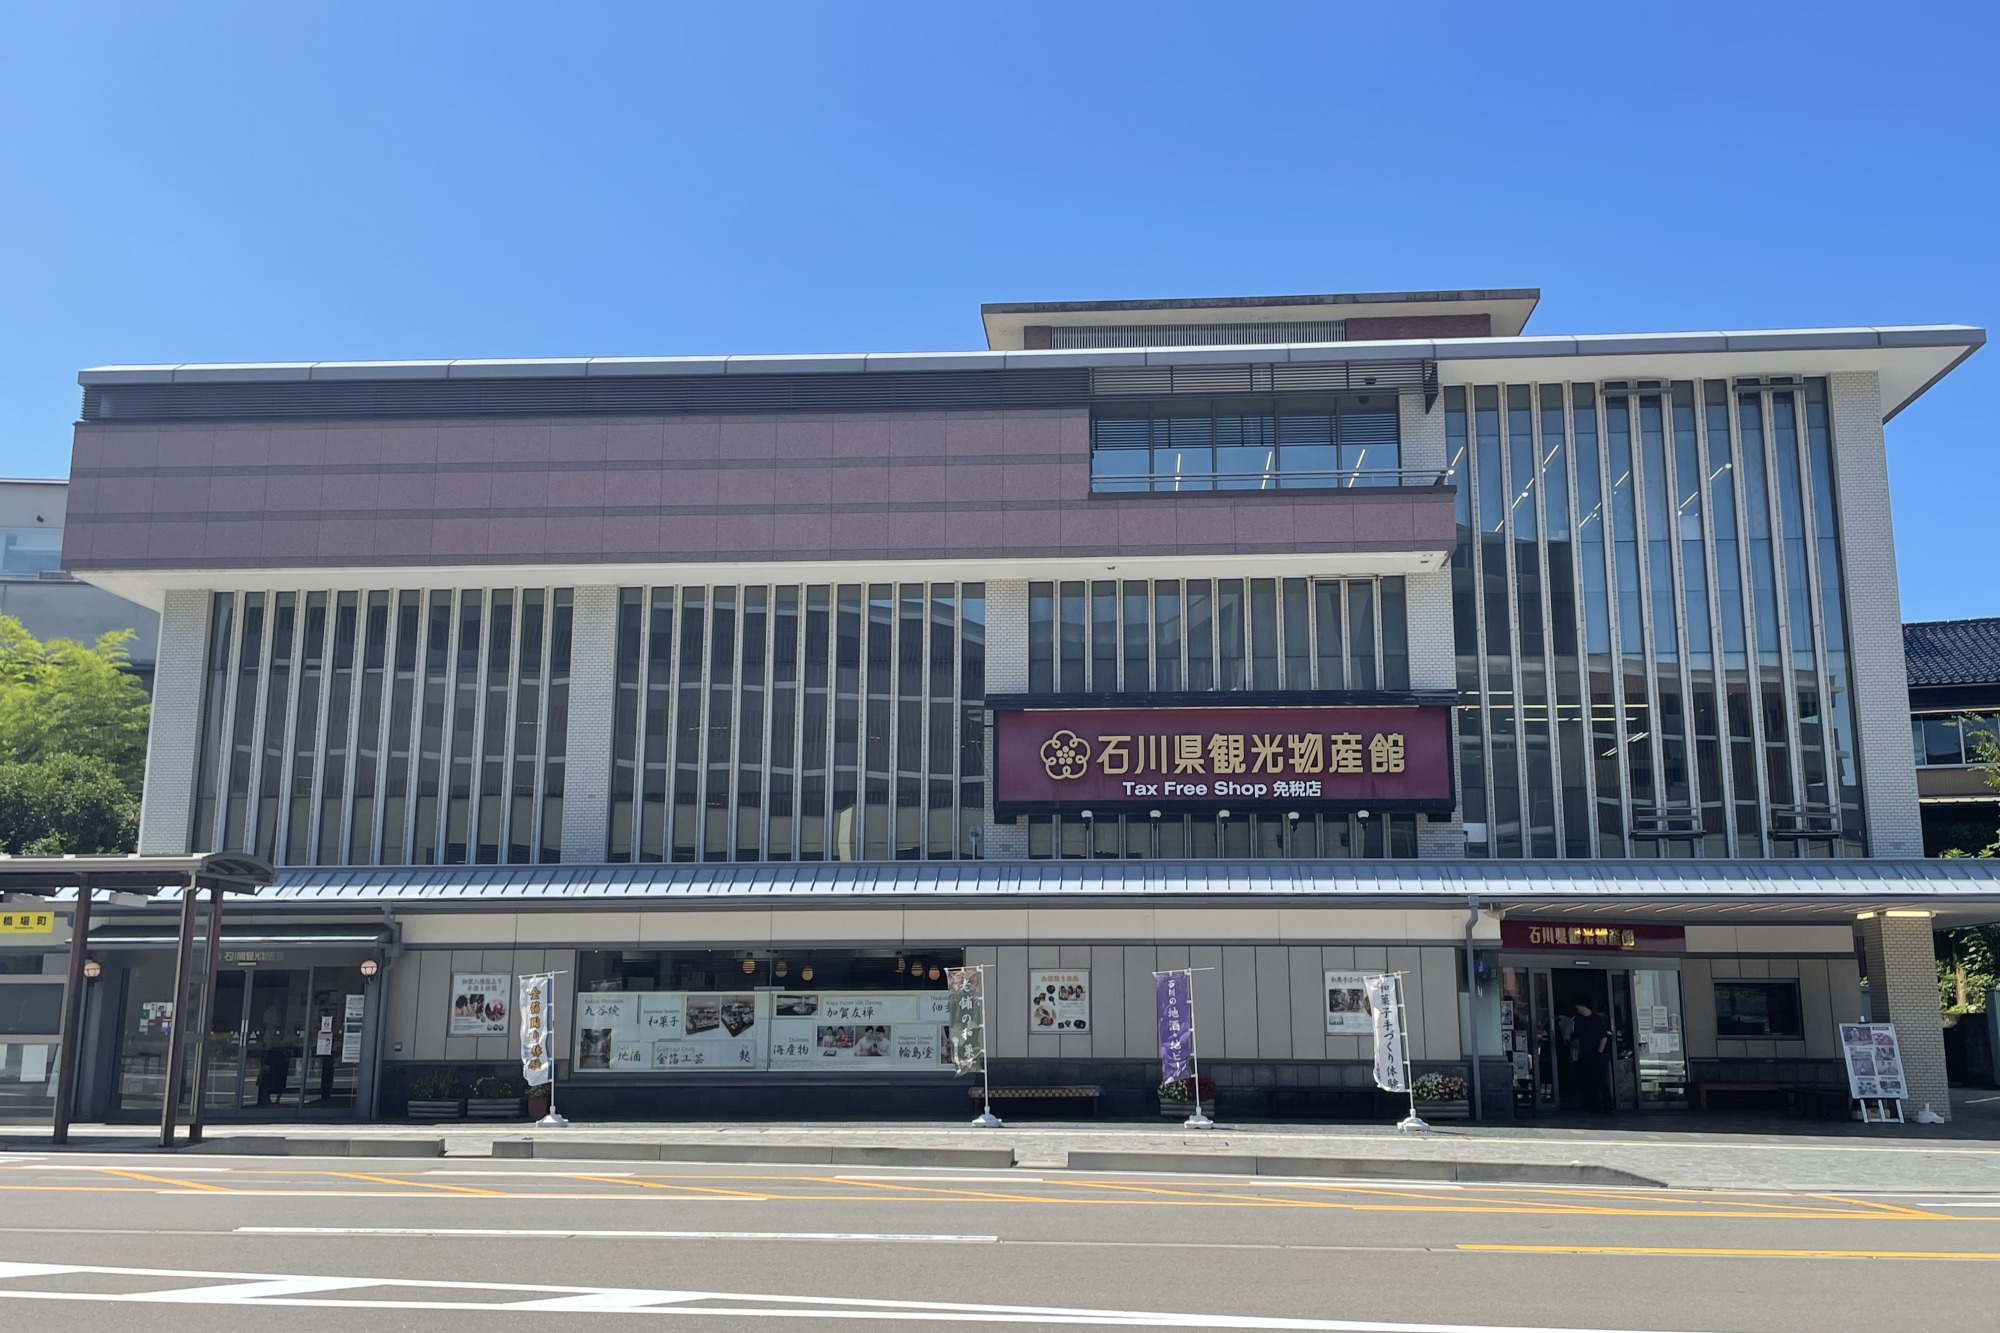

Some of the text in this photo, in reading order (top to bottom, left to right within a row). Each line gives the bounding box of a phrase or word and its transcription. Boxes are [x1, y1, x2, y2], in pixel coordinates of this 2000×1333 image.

[1096, 732, 1405, 774] 石川県観光物産館
[1122, 780, 1322, 799] Tax Free Shop 免税店
[648, 1015, 680, 1027] 和菓子
